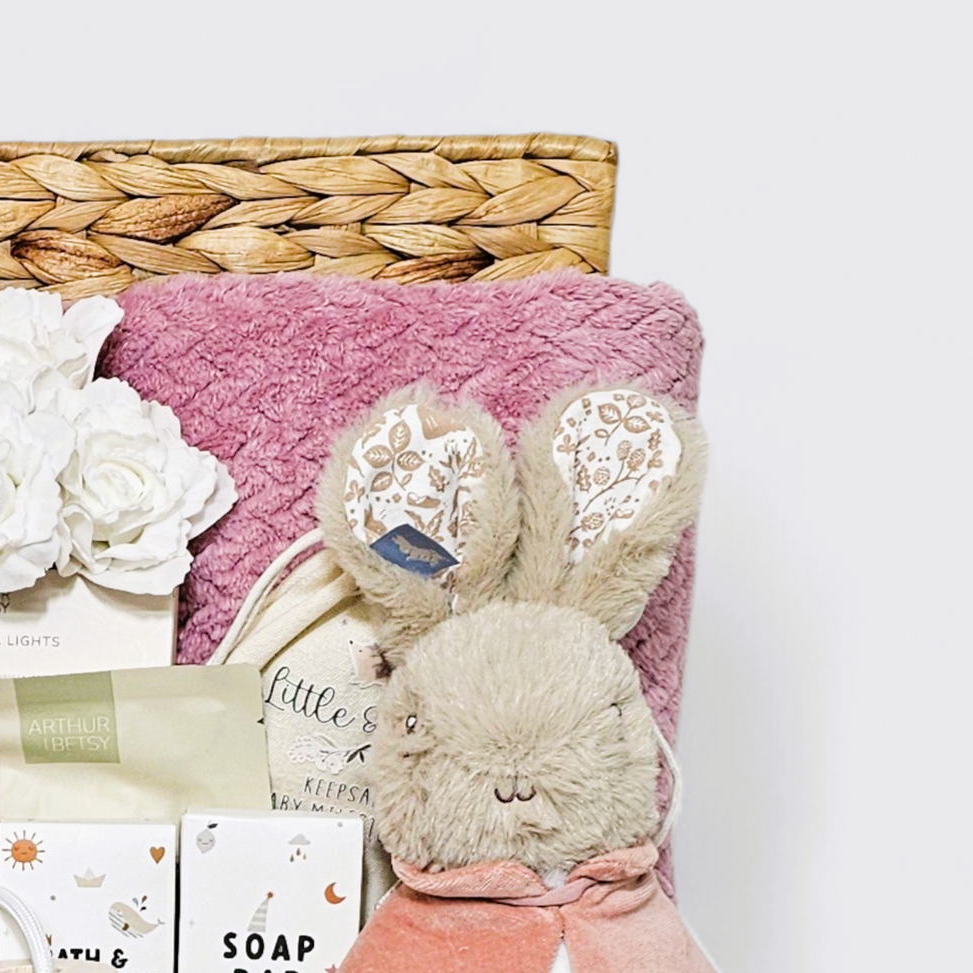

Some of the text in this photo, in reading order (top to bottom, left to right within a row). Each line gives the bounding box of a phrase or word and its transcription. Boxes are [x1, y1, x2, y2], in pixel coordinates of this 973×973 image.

[7, 635, 60, 648] LIGHTS
[265, 666, 356, 728] Little
[28, 716, 110, 735] ARTHUR
[52, 735, 110, 752] BETSY
[304, 776, 375, 807] KEEPSA
[223, 932, 315, 962] SOAP
[50, 948, 128, 969] ATH &
